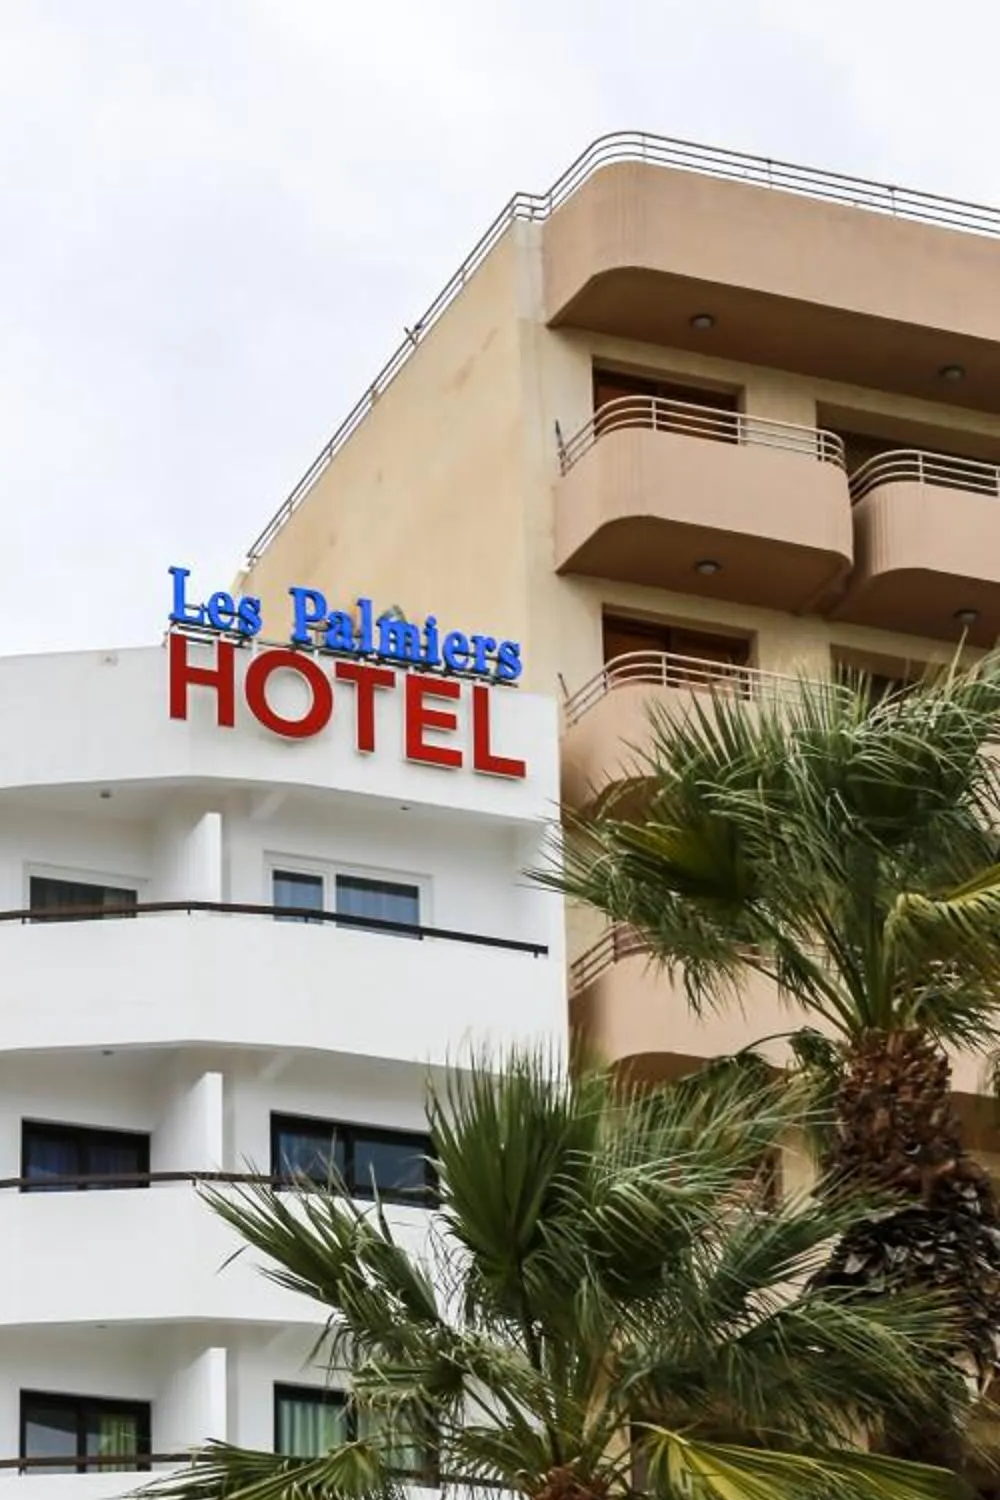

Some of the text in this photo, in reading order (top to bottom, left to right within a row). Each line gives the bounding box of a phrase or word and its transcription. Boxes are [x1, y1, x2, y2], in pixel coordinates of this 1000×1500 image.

[167, 565, 523, 680] Les Palmiers
[168, 632, 527, 779] HOTEL
